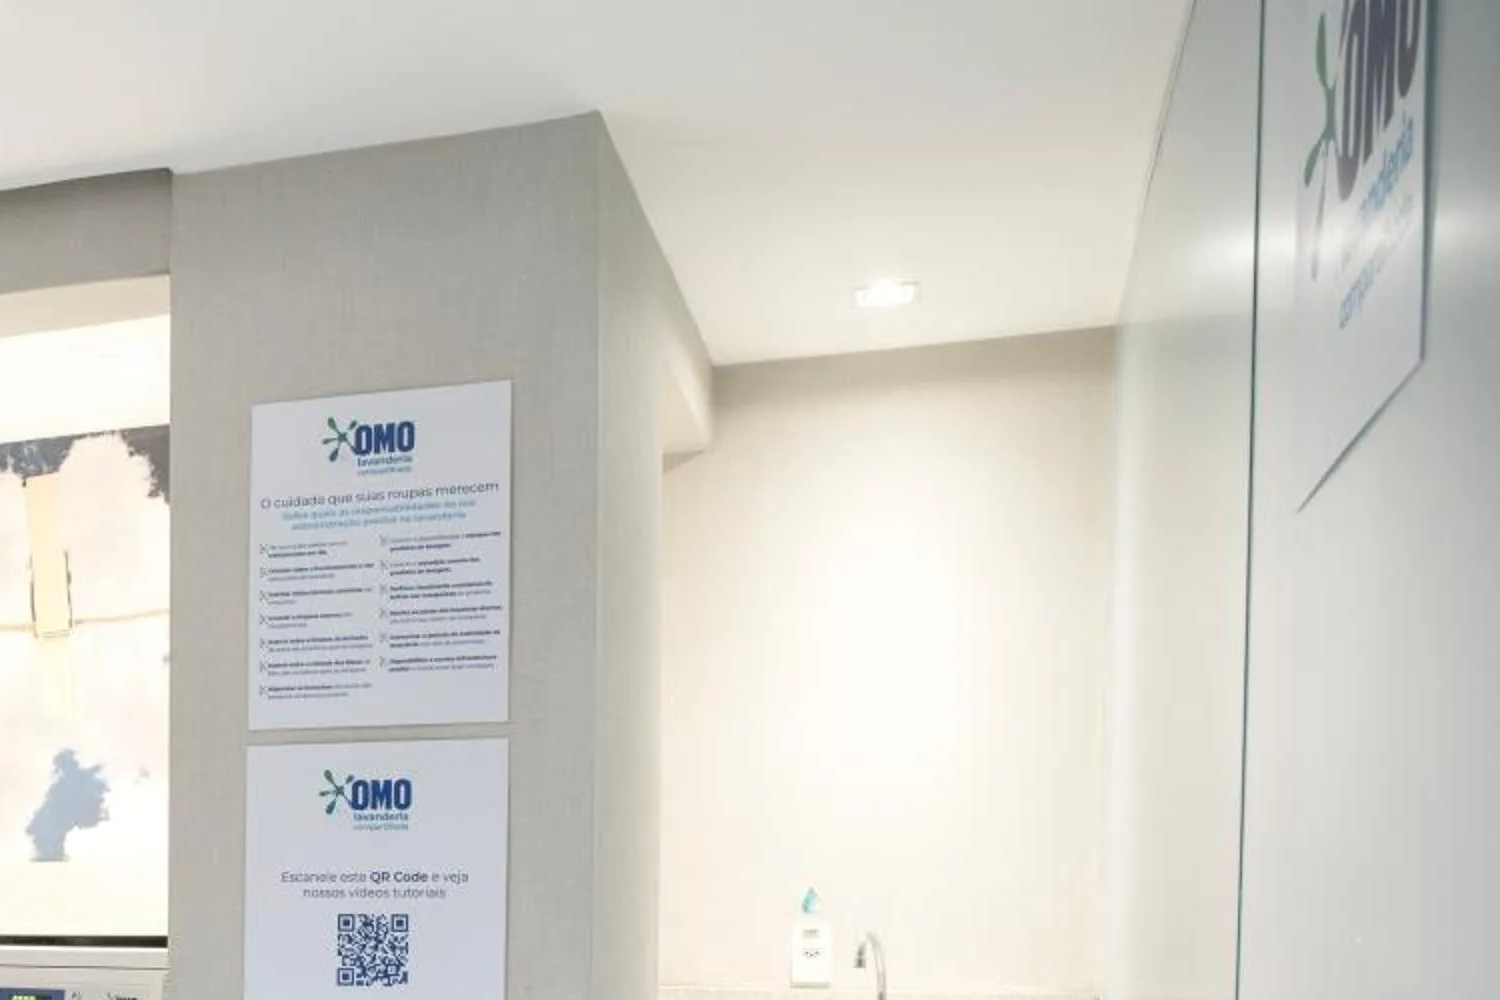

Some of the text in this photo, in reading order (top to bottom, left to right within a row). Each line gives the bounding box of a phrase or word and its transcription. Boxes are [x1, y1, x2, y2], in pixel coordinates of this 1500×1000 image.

[352, 421, 415, 455] OMO
[260, 481, 499, 510] O cuidado que suas roupas merecem
[350, 778, 412, 811] OMO
[353, 812, 409, 821] lavanderia
[281, 871, 337, 883] Escaneie
[370, 872, 391, 885] QR
[393, 871, 429, 883] Code
[431, 873, 440, 883] e
[443, 871, 469, 885] veja
[303, 886, 447, 899] nossos vídeos tutoriais
